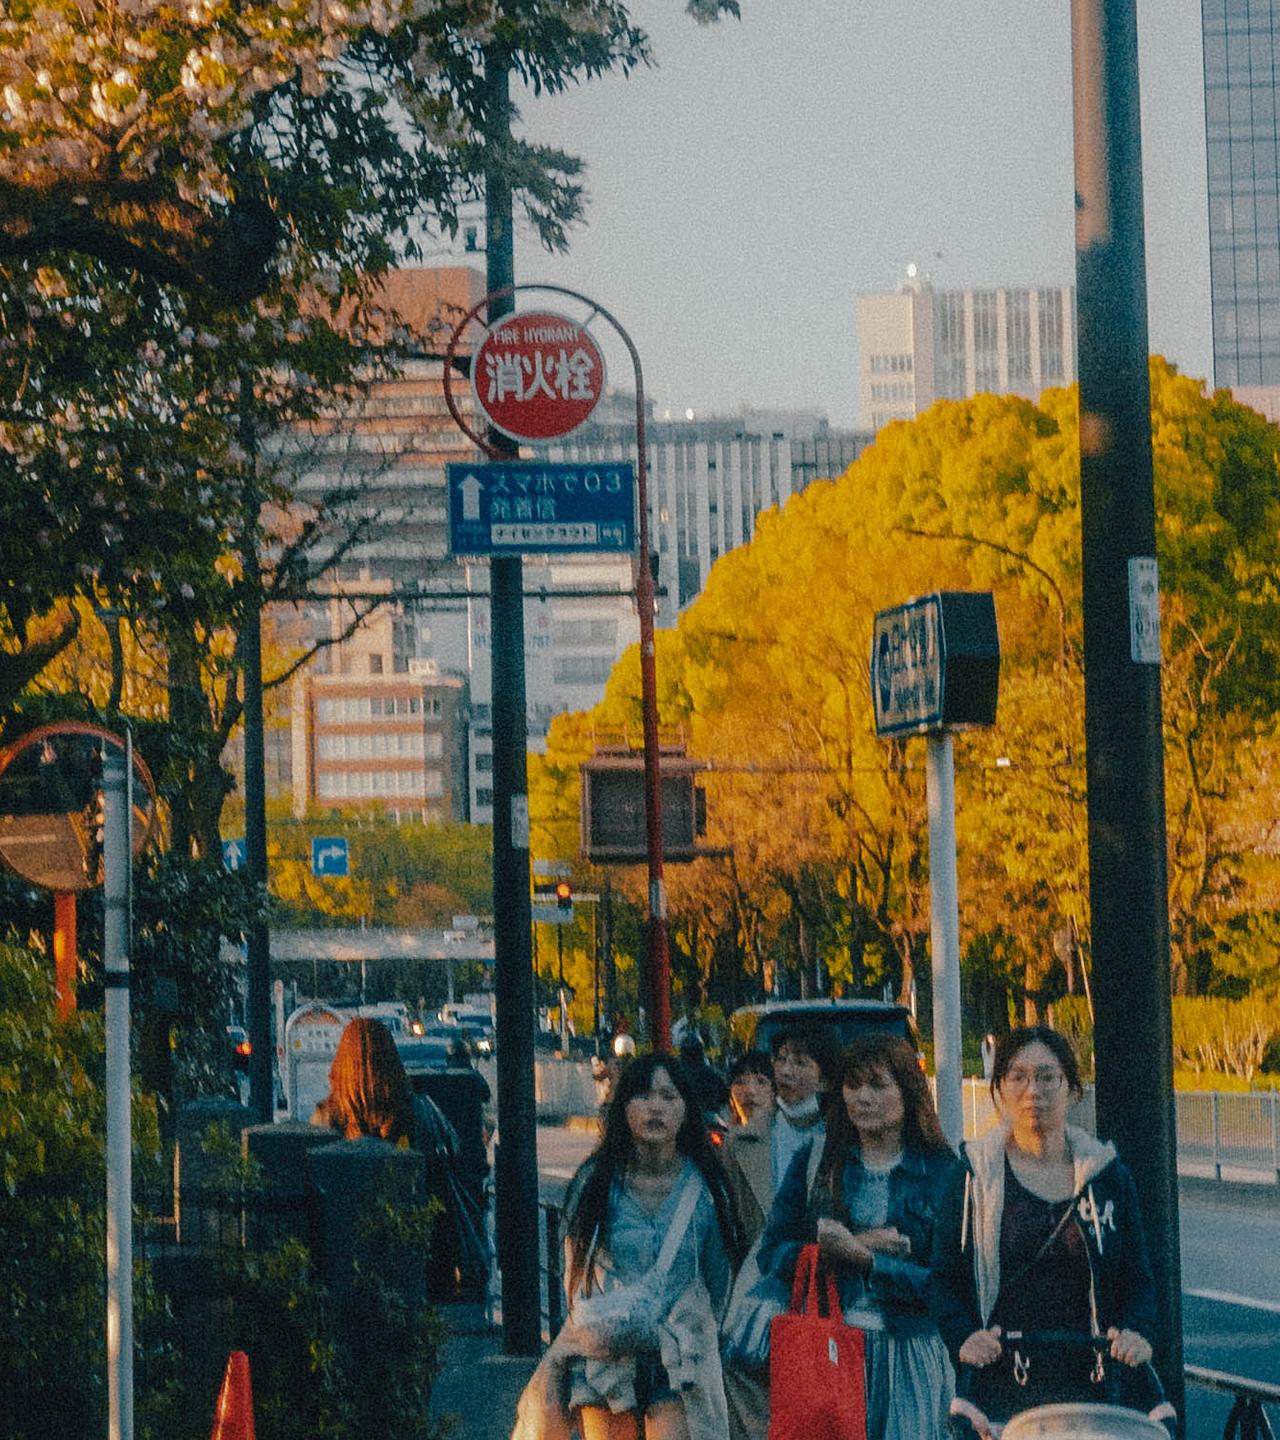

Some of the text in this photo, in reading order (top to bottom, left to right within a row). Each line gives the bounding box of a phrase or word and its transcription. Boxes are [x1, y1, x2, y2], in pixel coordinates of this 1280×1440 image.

[493, 326, 579, 344] FIRE HYDRANT
[485, 348, 594, 403] 消火栓
